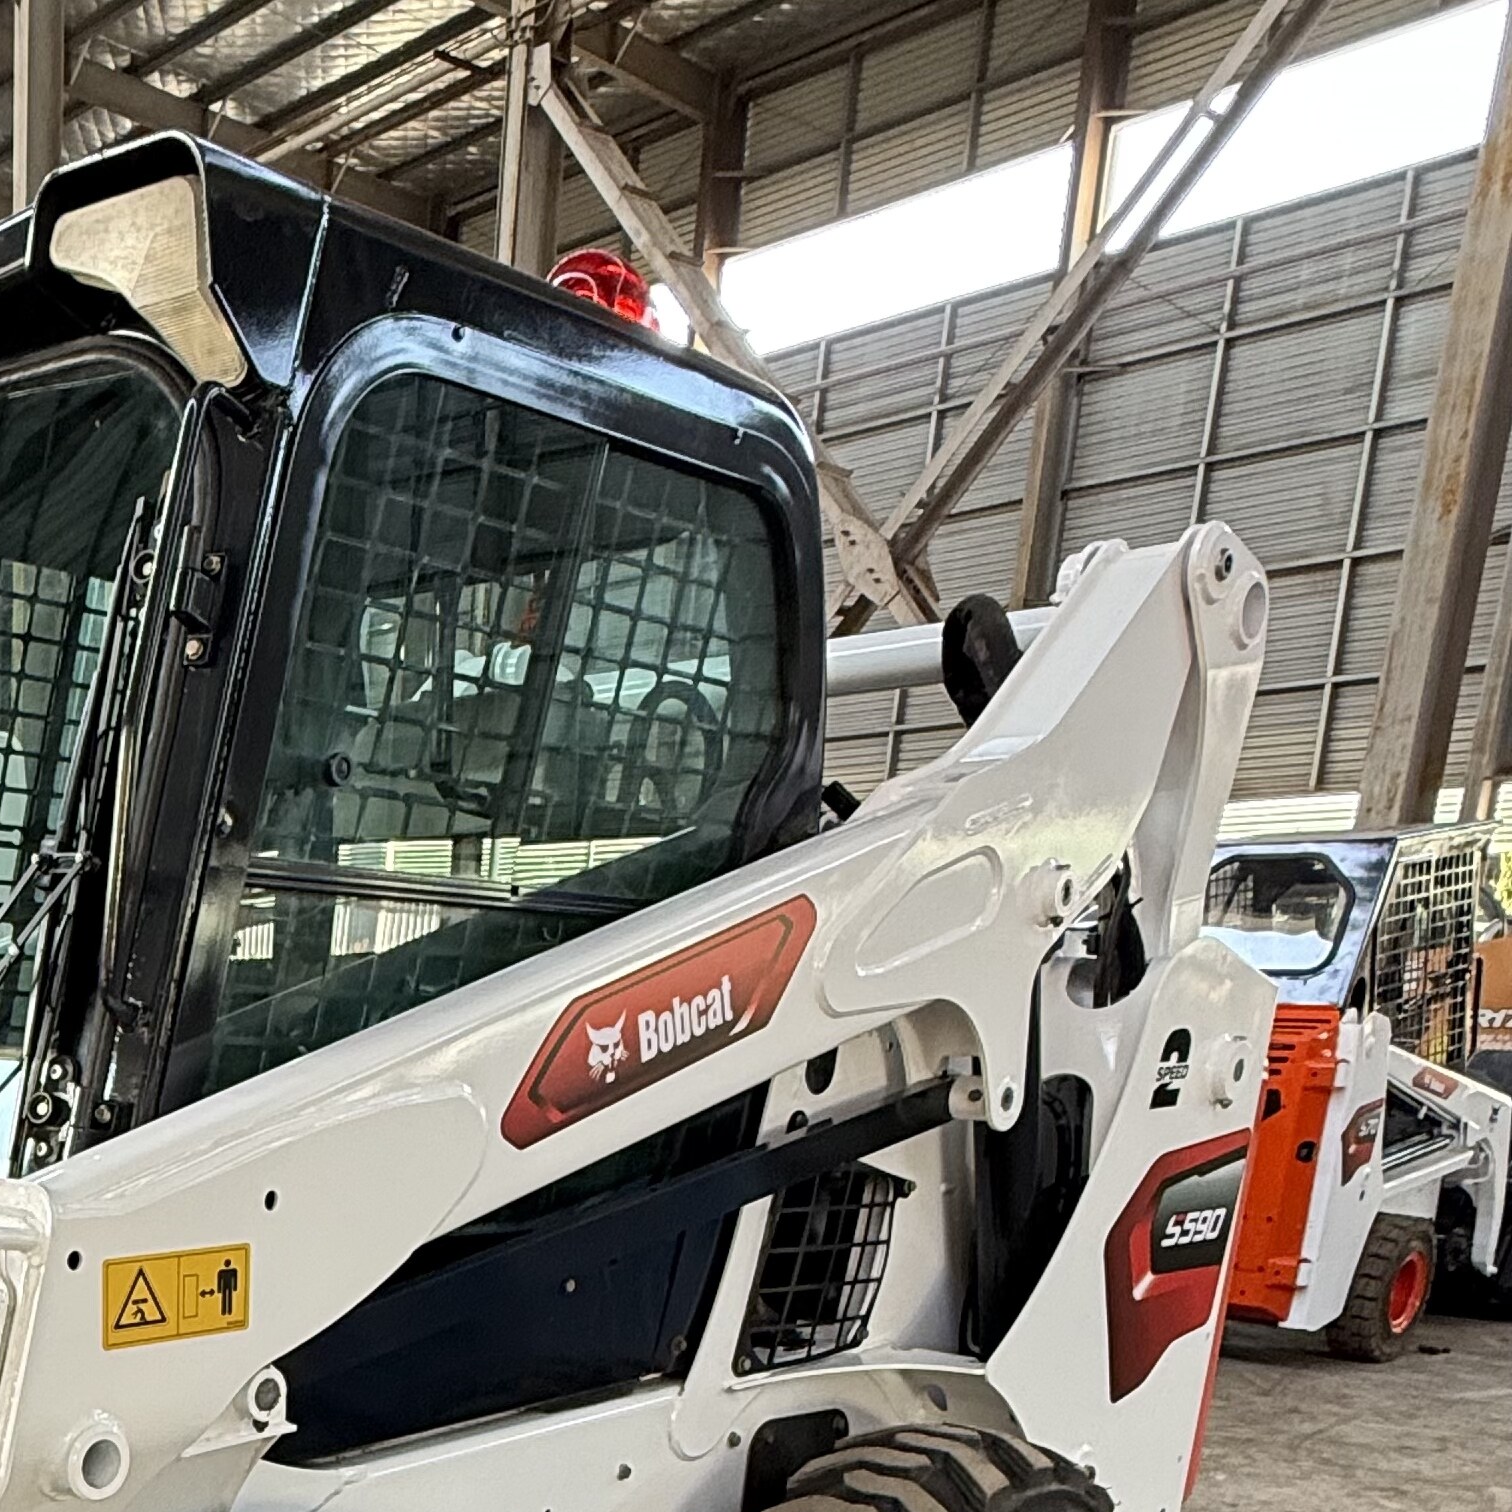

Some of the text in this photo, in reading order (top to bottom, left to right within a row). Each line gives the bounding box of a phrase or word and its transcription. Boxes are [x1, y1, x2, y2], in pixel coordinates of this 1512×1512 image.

[637, 974, 734, 1063] Bobcat
[1149, 1028, 1192, 1110] 2
[1155, 1064, 1190, 1083] SPEED
[1160, 1207, 1227, 1248] S590
